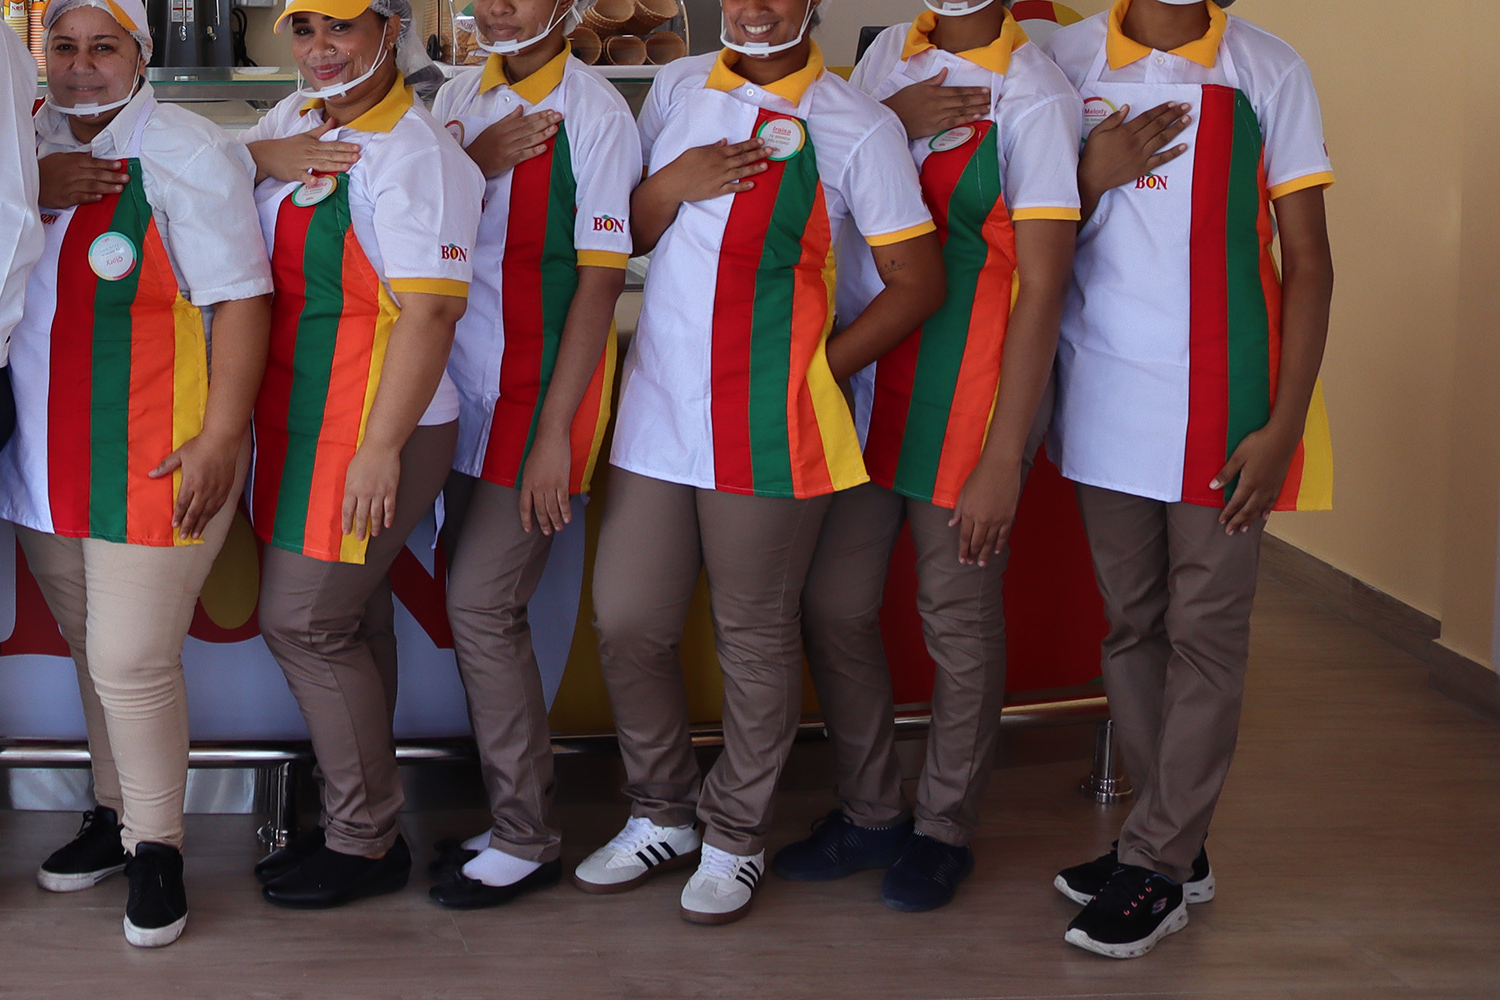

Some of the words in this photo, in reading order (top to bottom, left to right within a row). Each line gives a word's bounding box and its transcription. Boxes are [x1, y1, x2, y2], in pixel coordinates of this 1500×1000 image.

[1084, 108, 1108, 116] Melody
[1135, 174, 1169, 190] BON
[592, 216, 626, 233] BON
[440, 244, 468, 263] BON
